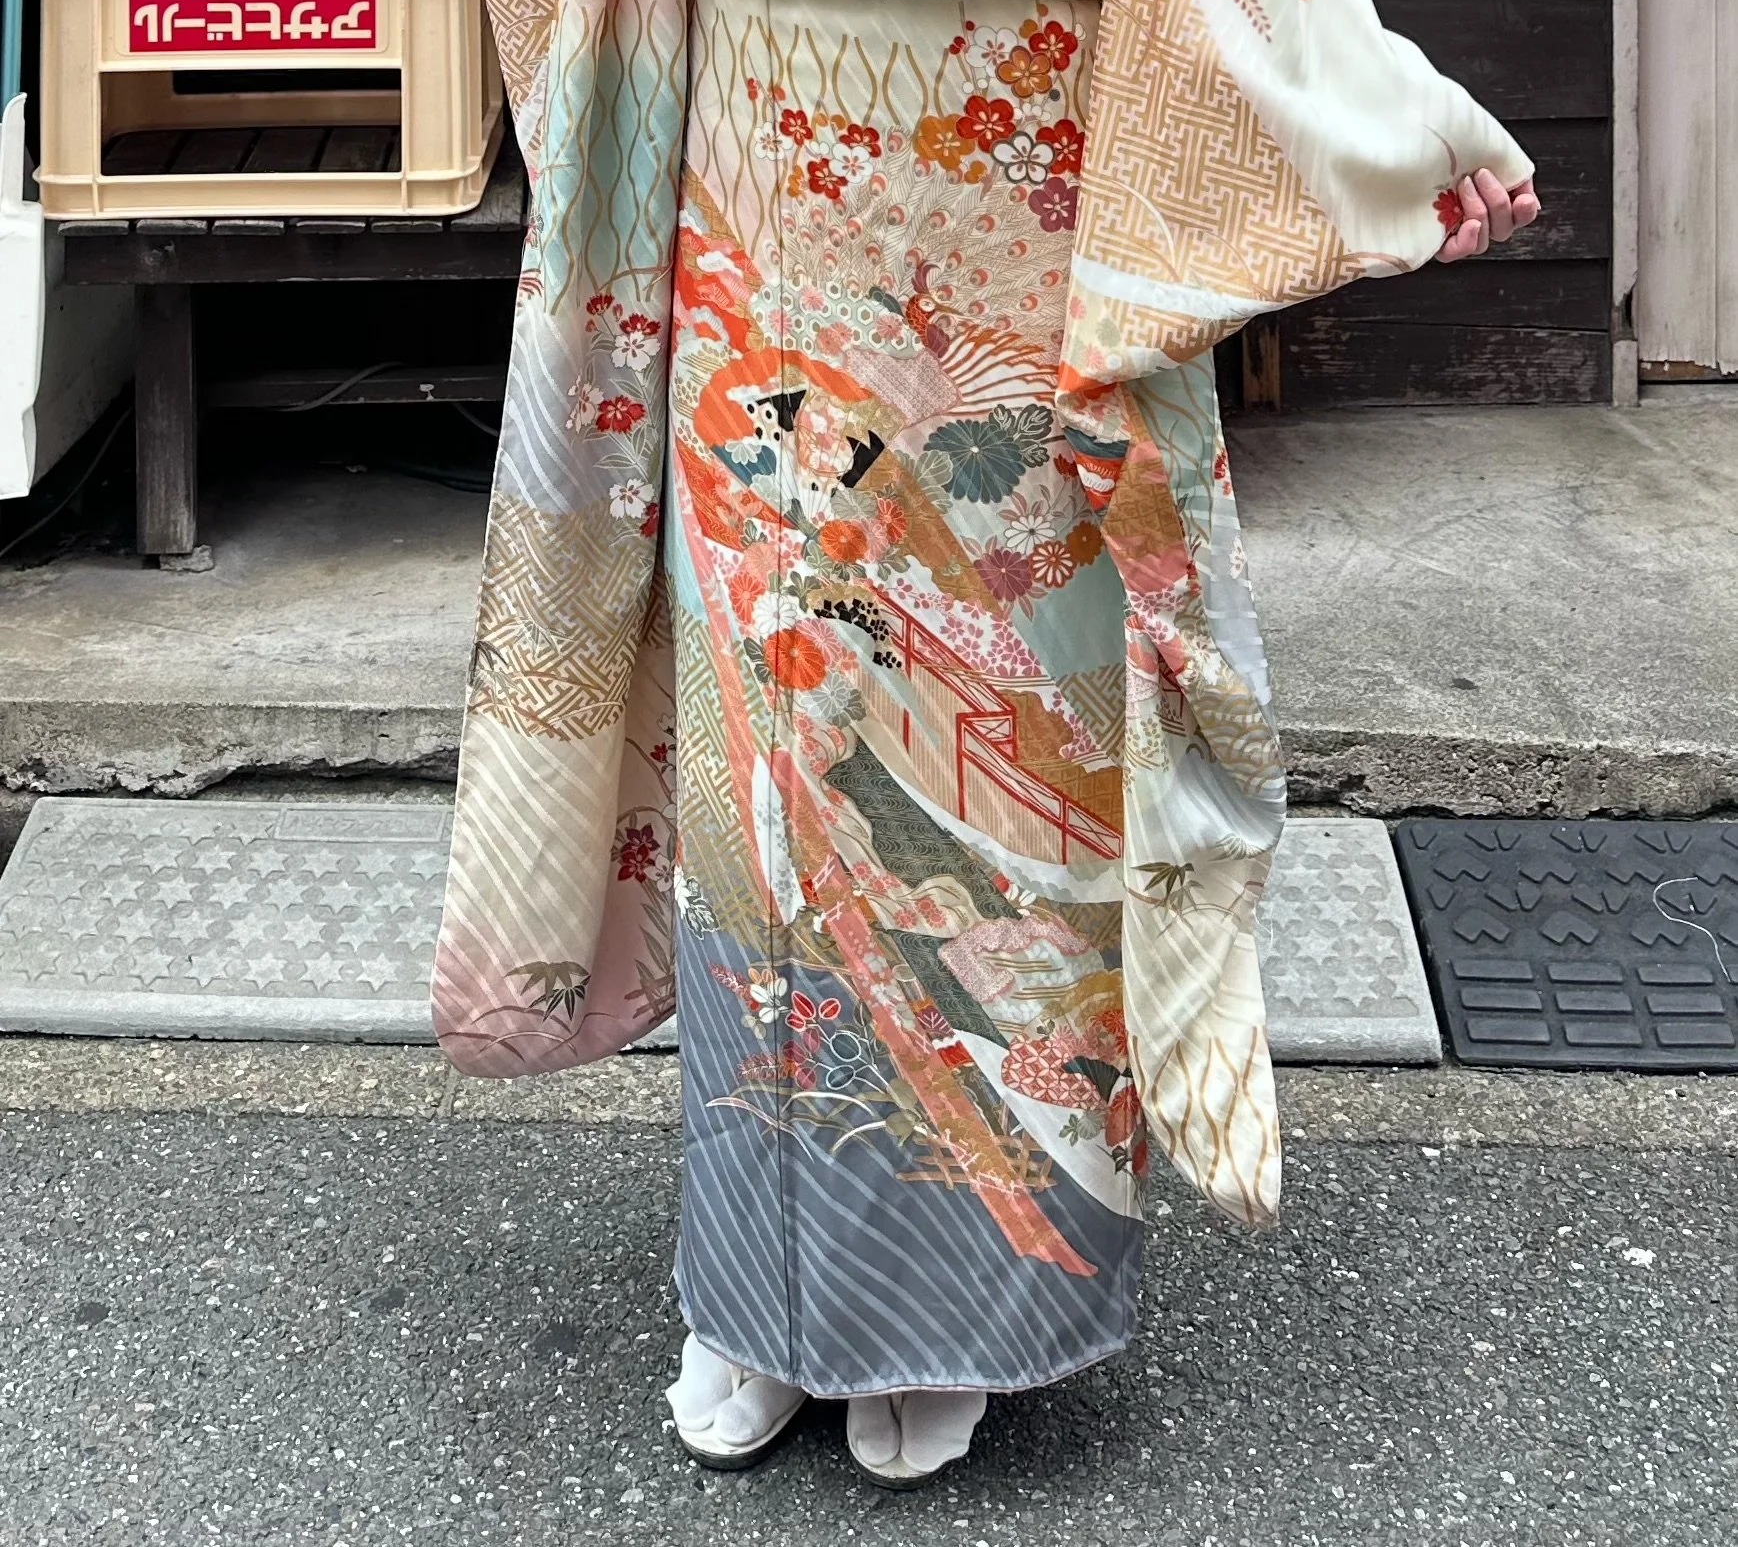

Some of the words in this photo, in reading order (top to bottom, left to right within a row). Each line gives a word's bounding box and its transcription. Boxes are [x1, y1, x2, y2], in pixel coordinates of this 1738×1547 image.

[133, 1, 372, 43] アサヒビール
